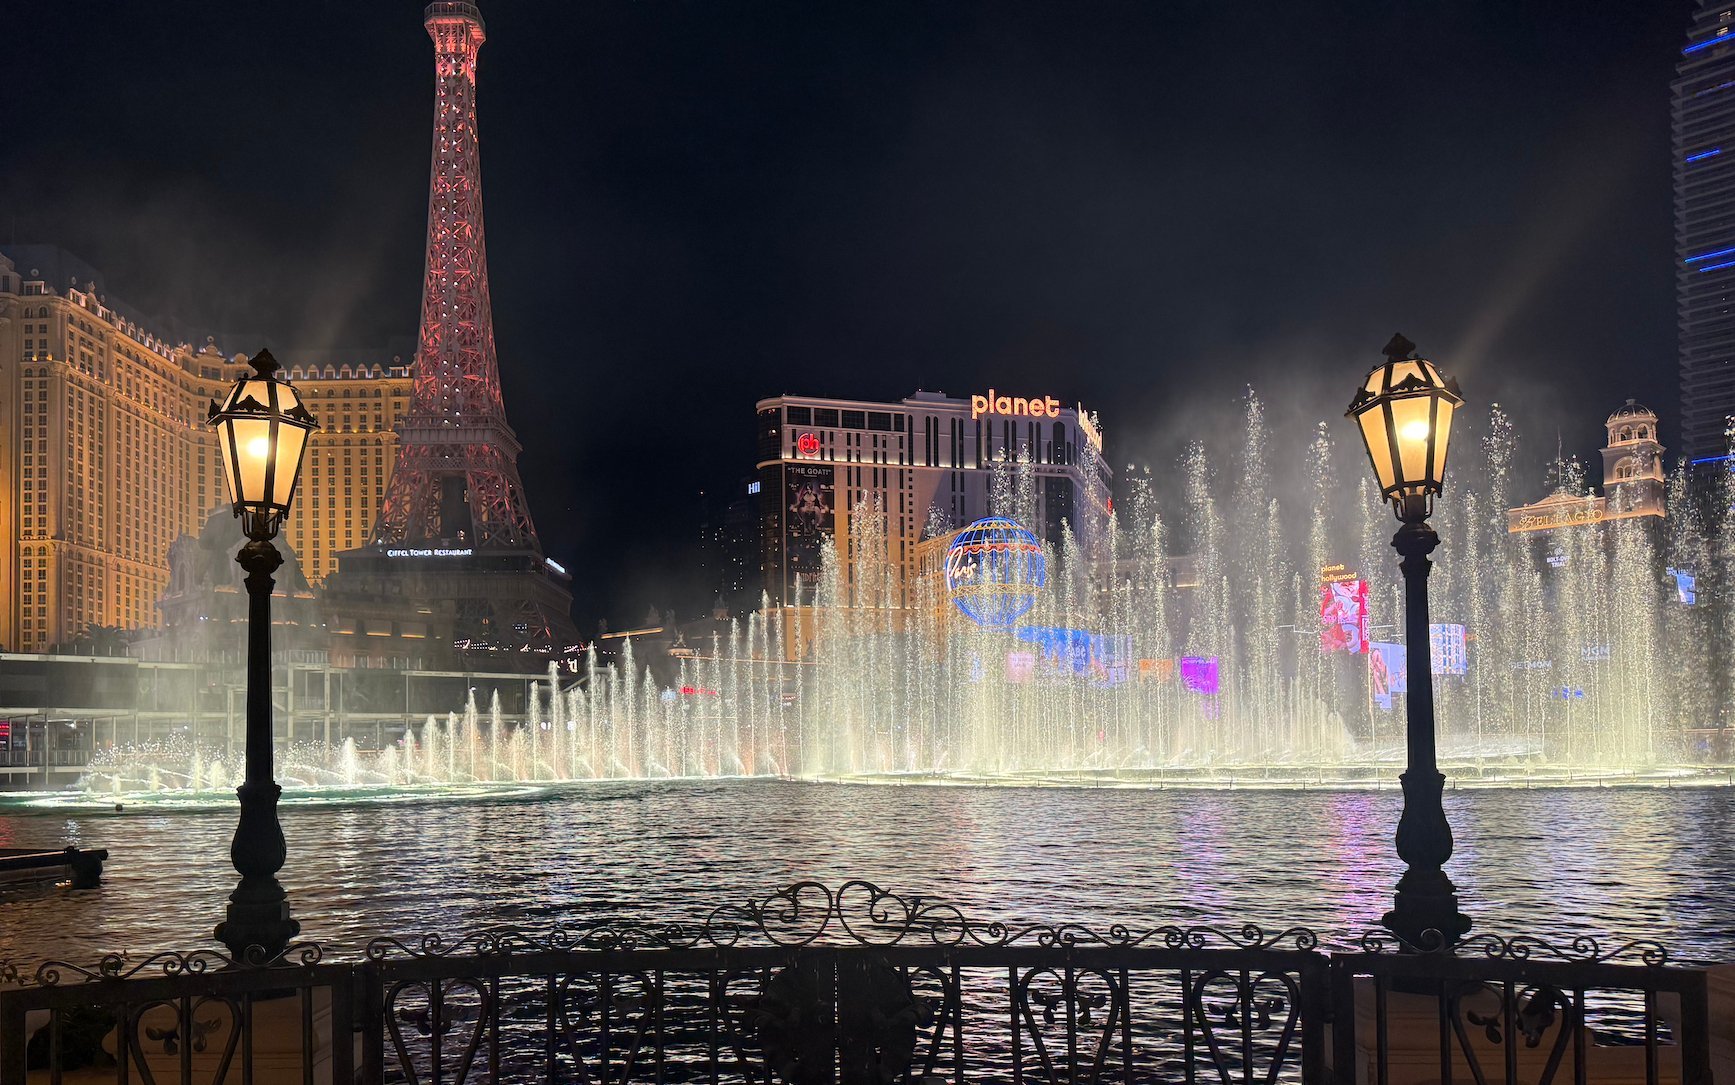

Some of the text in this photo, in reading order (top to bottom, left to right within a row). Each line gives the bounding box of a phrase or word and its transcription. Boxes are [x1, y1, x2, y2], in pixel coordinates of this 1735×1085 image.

[971, 388, 1060, 419] planet
[748, 481, 761, 495] Hil
[386, 548, 473, 557] EIFFEL TOWER RESTAURANT
[946, 545, 977, 593] Paris
[1321, 564, 1345, 574] planet
[1321, 572, 1357, 583] hollywood
